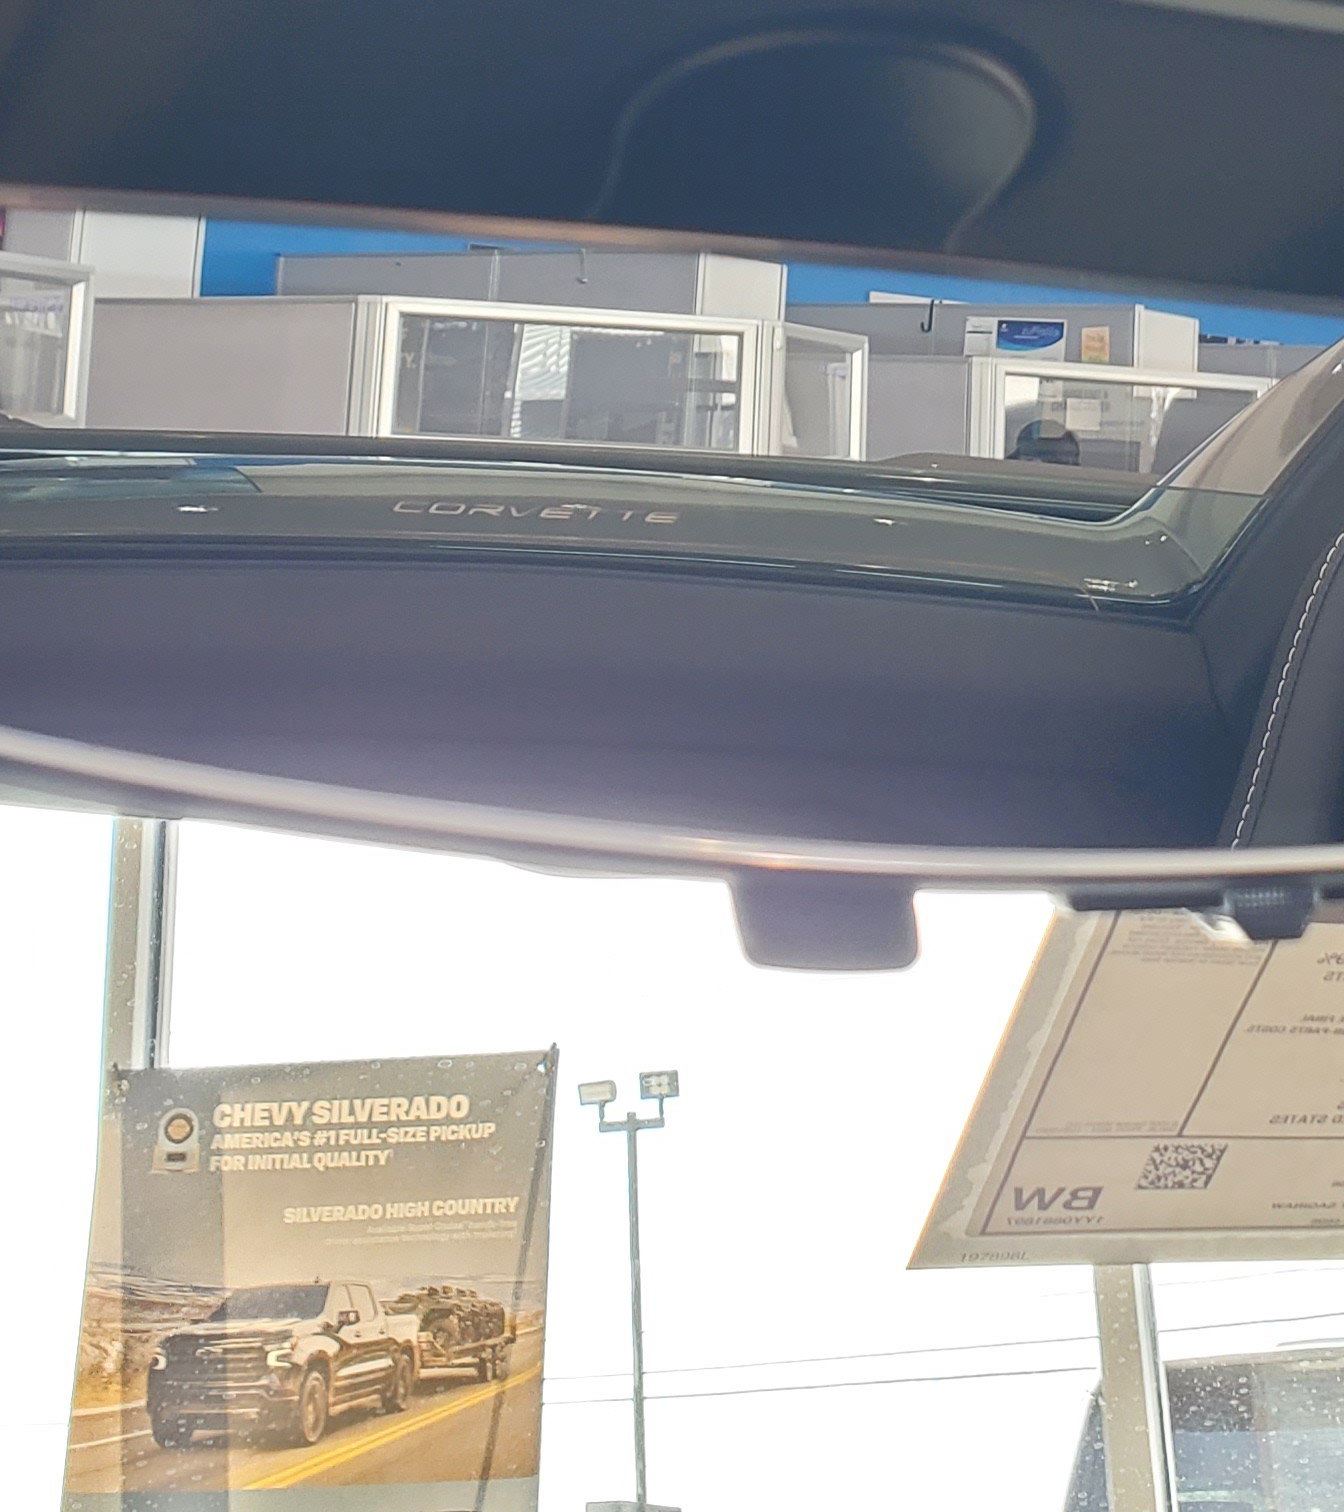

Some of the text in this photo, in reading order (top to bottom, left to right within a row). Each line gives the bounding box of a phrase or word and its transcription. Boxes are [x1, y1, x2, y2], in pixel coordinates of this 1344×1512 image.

[212, 1094, 471, 1128] CHEVY SILVERADO
[210, 1122, 497, 1150] AMERICA'S #1 FULL-SIZE PICKUP
[209, 1154, 245, 1172] FOR
[247, 1152, 311, 1171] INITIAL
[282, 1196, 520, 1224] SILVERADO HIGH COUNTRY
